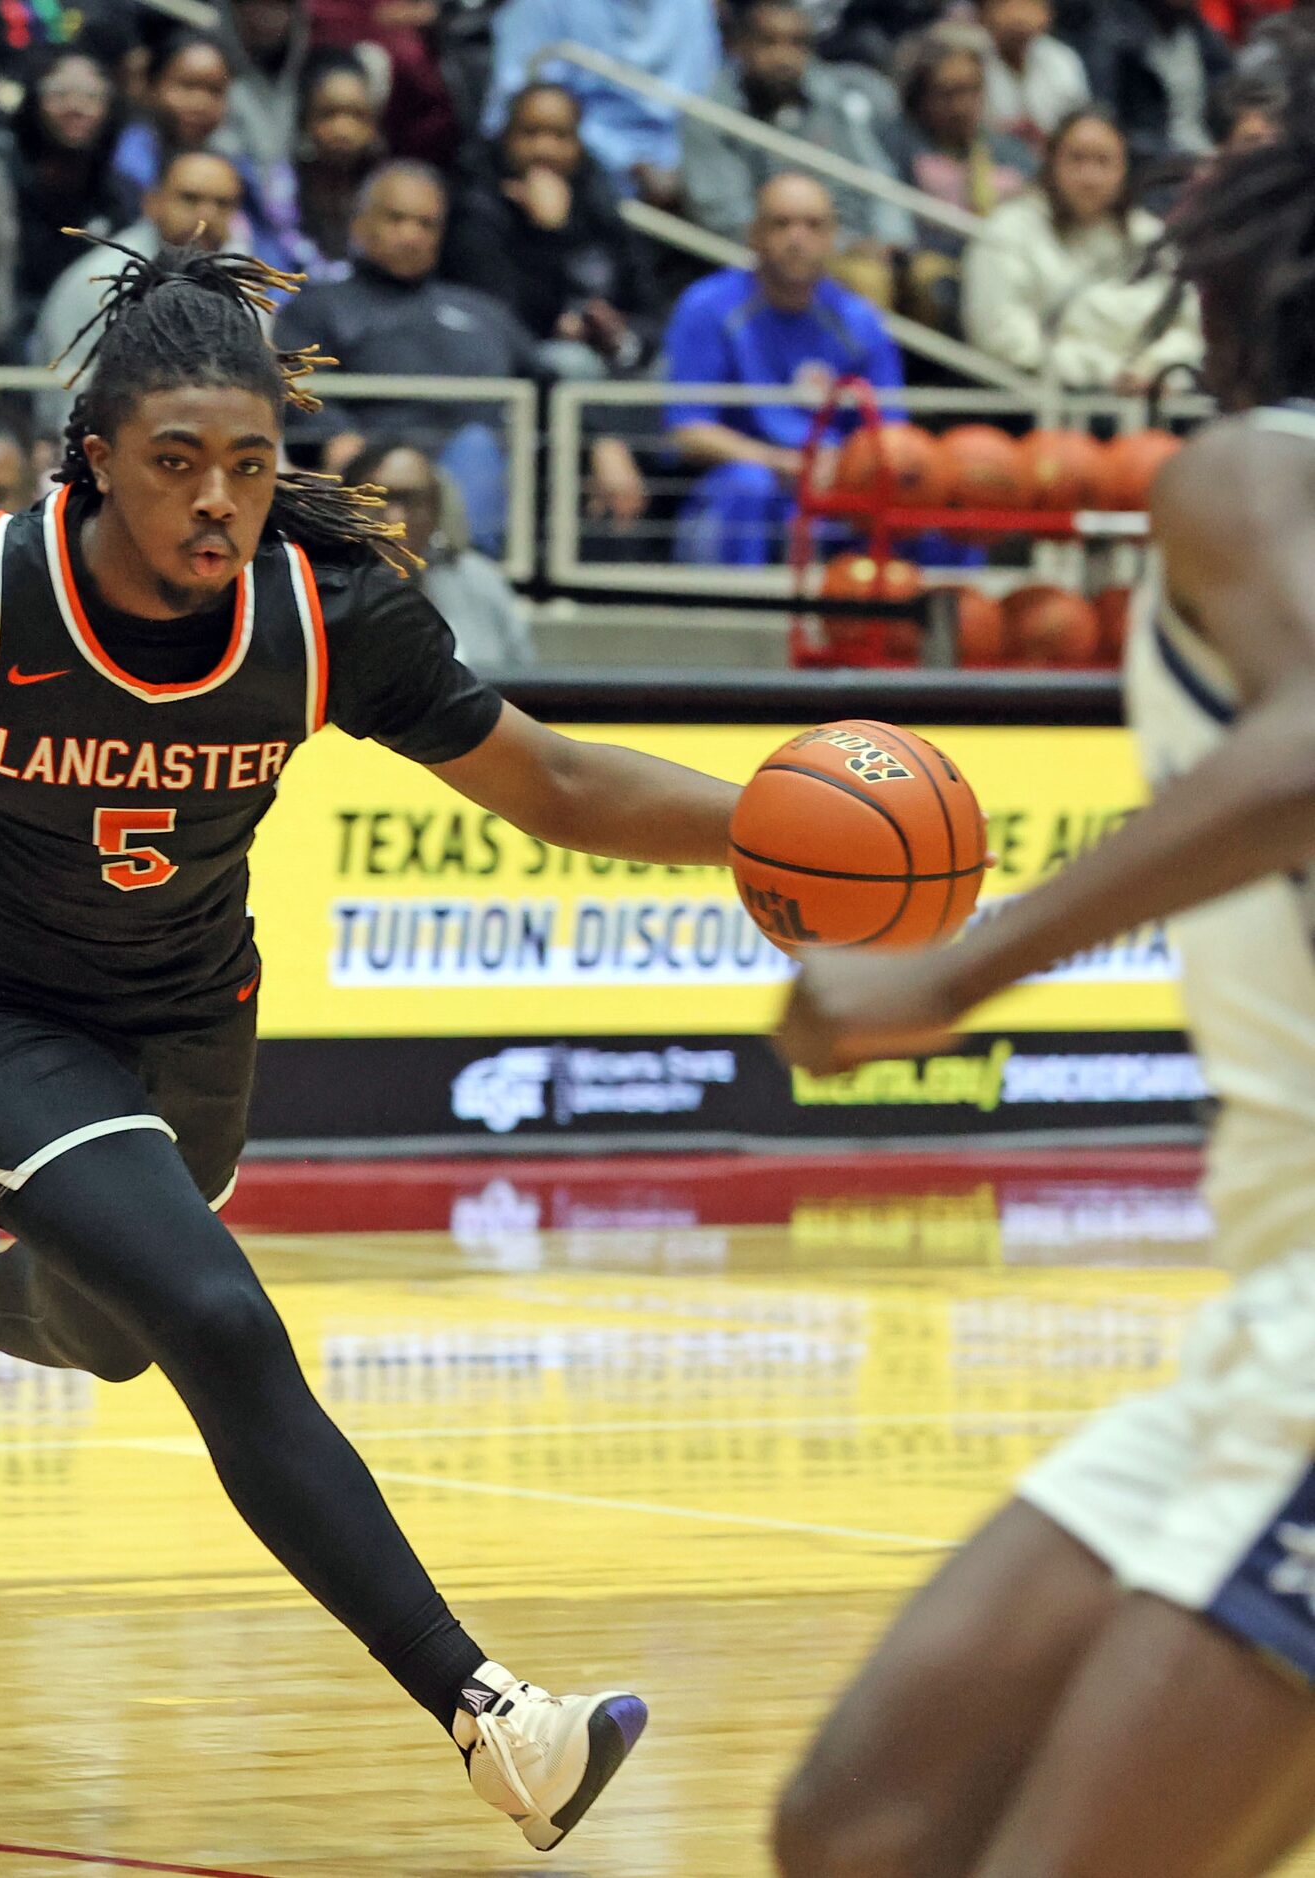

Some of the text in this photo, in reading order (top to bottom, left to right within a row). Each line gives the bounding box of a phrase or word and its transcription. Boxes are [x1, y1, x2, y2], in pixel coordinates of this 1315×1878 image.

[92, 806, 179, 892] 5
[334, 811, 501, 875] TEXAS
[337, 906, 785, 970] TUITION DISCOU
